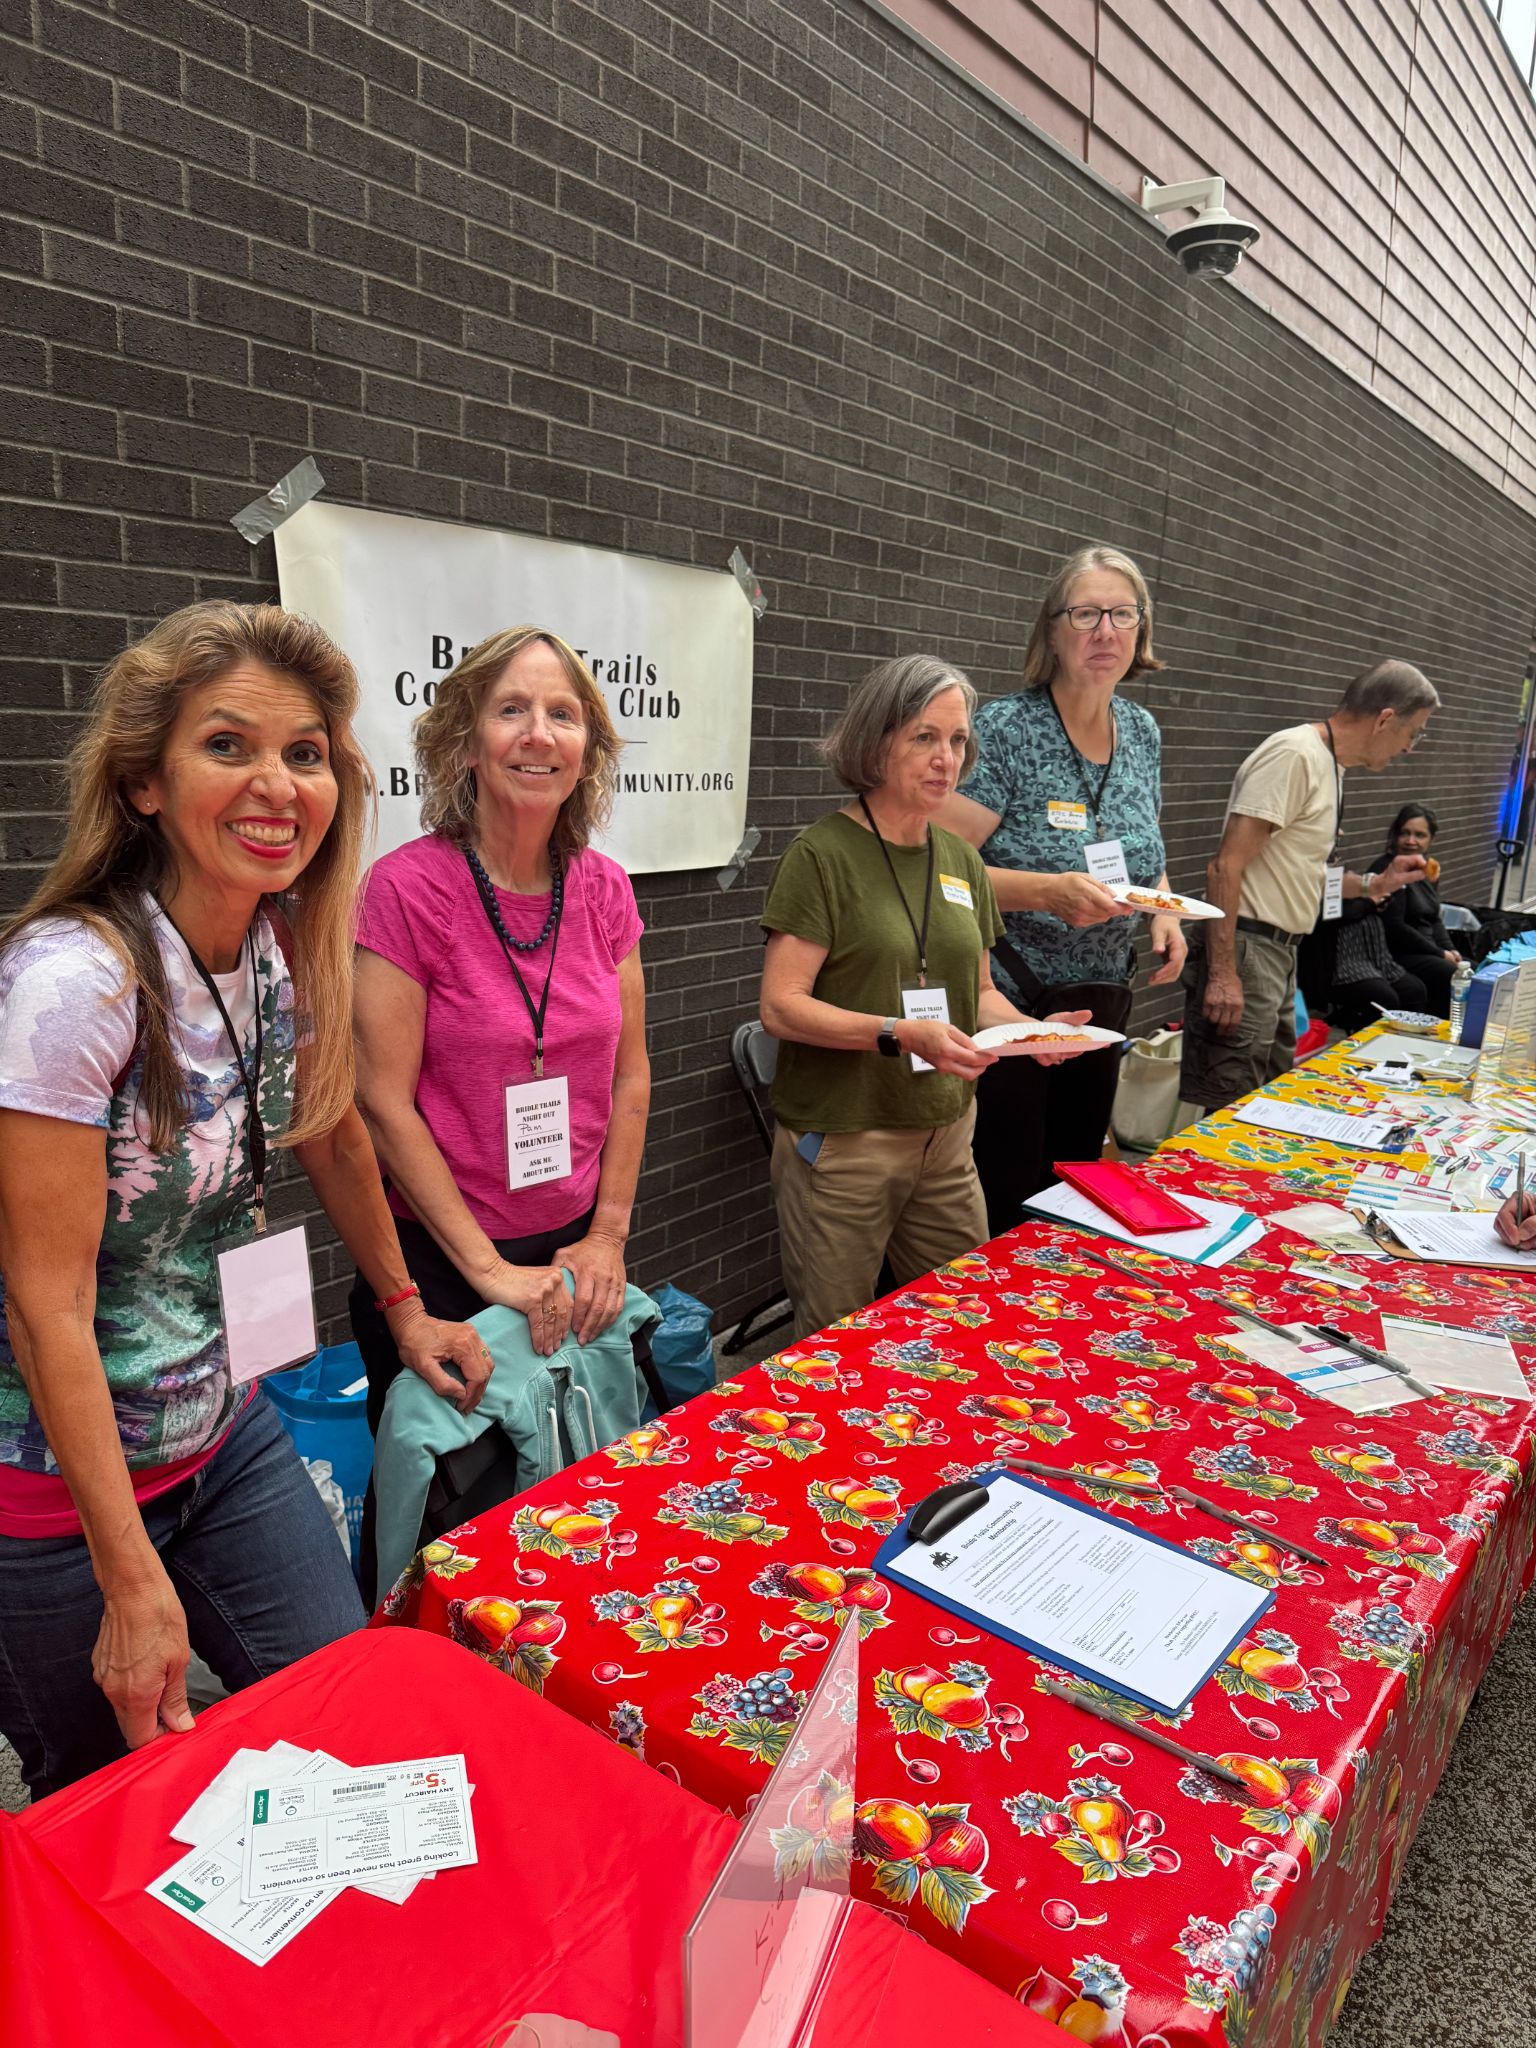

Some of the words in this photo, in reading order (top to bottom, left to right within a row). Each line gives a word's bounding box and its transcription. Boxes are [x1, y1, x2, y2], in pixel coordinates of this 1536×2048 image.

[619, 688, 680, 718] Club
[516, 1103, 538, 1113] BRIDLE
[538, 1099, 561, 1110] TRAILS
[523, 1113, 542, 1122] NIGHT
[543, 1111, 555, 1119] OUT
[515, 1133, 563, 1150] VOLUNTEER
[529, 1158, 541, 1167] ASK
[522, 1169, 542, 1179] ABOUT
[959, 1537, 978, 1549] Bridle
[973, 1527, 990, 1538] Trails
[984, 1508, 1014, 1529] Community
[1007, 1499, 1023, 1510] Club
[987, 1517, 1017, 1540] Membership
[278, 1793, 304, 1801] check-in
[403, 1789, 436, 1798] HAIRCUT
[279, 1798, 304, 1806] ONLINE
[396, 1855, 421, 1866] great
[423, 1849, 458, 1862] Looking
[352, 1864, 377, 1874] never
[379, 1861, 395, 1869] has
[327, 1869, 350, 1879] been
[258, 1875, 312, 1891] convenient.
[302, 1898, 315, 1908] so
[260, 1906, 307, 1948] convenient.
